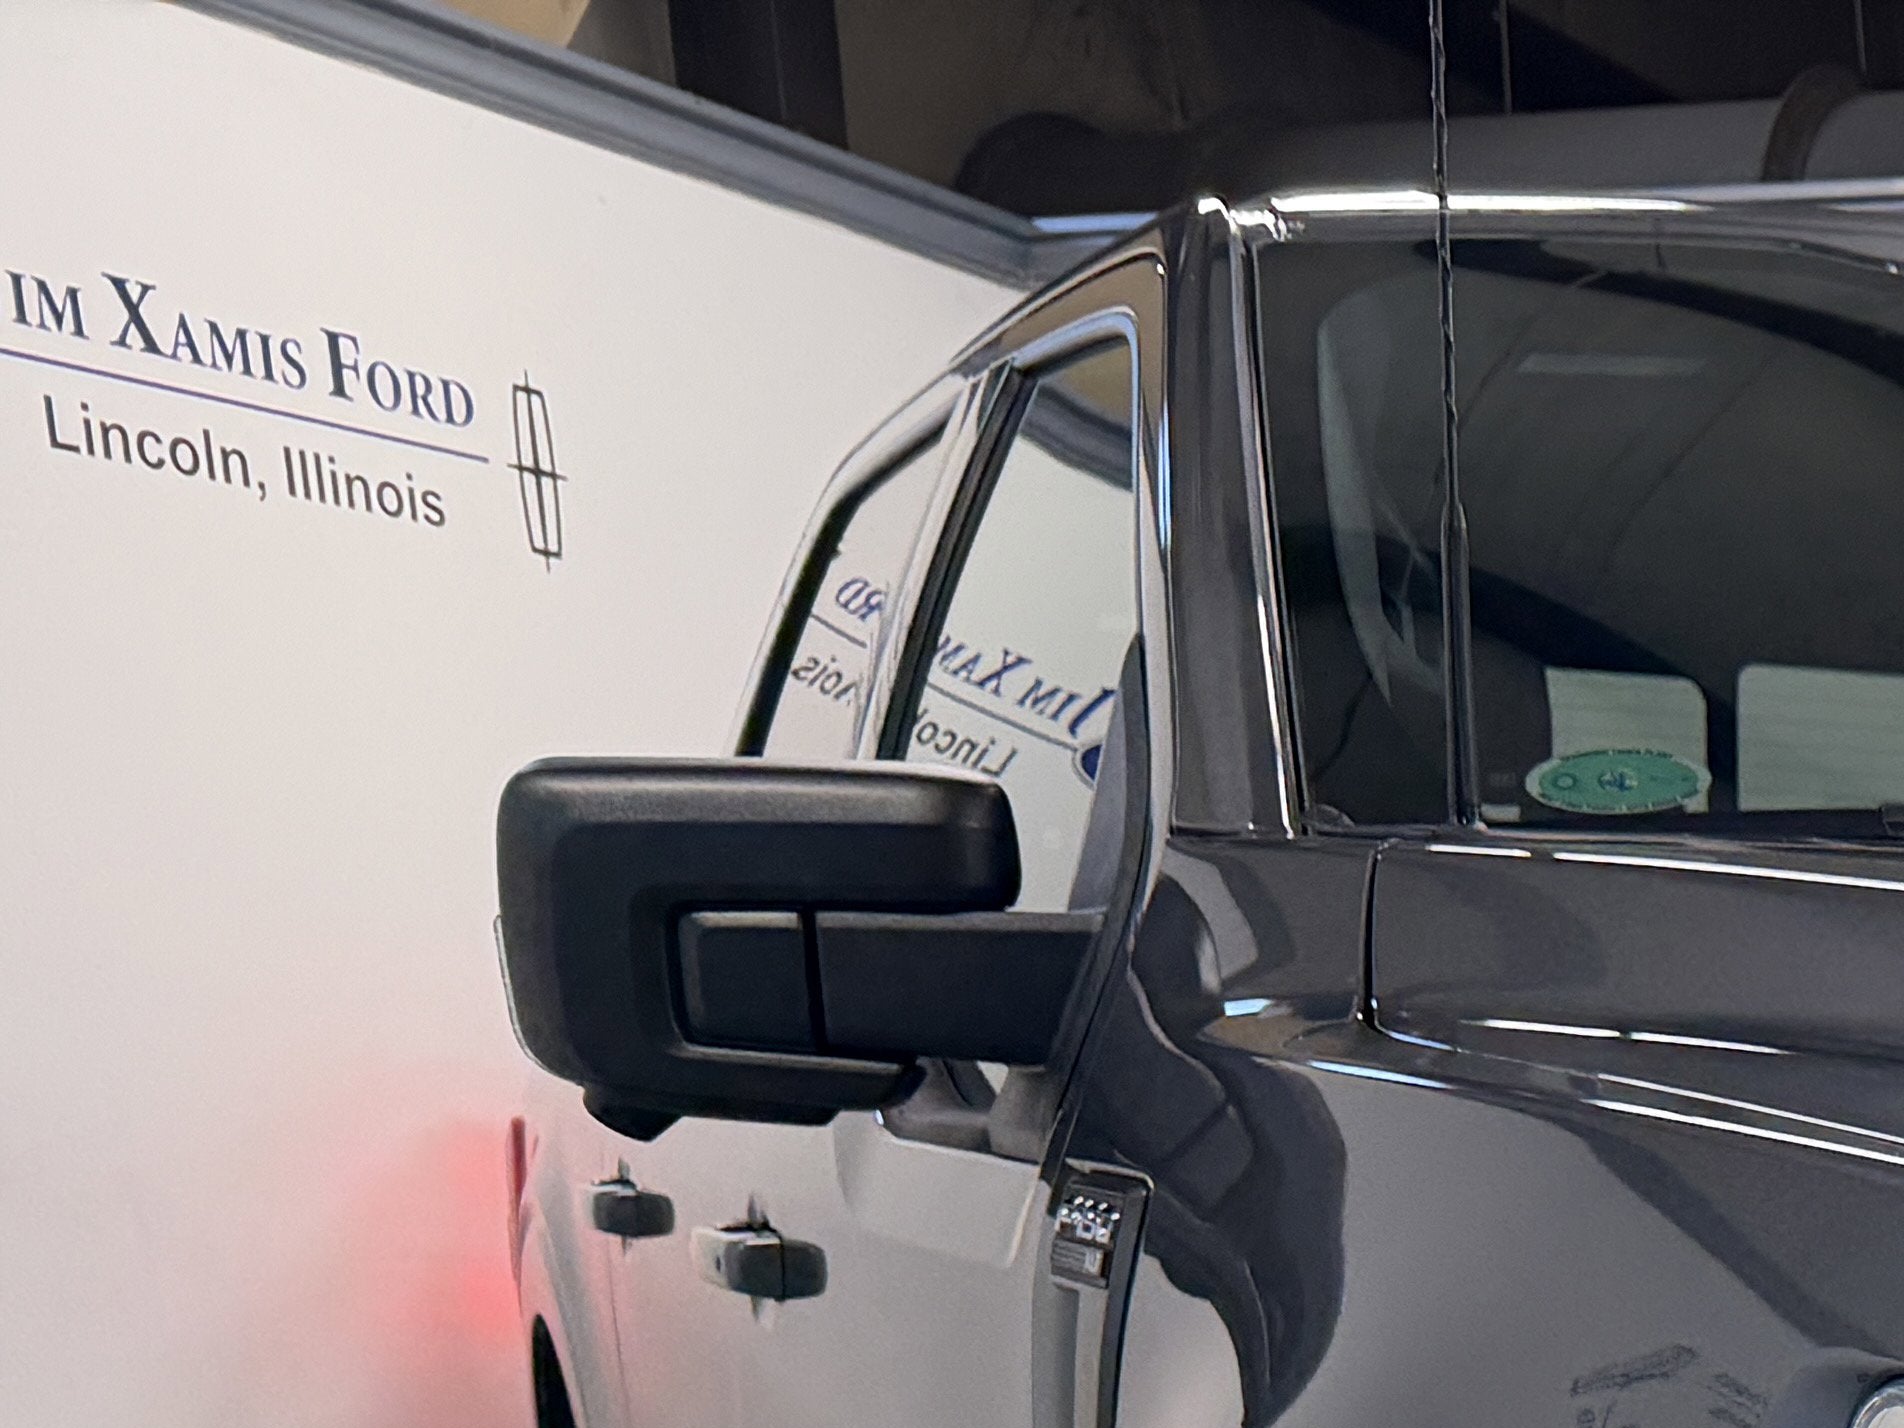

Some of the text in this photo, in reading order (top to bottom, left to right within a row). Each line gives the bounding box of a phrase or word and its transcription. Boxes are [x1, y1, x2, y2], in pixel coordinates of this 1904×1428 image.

[3, 268, 476, 428] IM XAMIS FORD
[43, 393, 447, 528] Lincoln, Illinois
